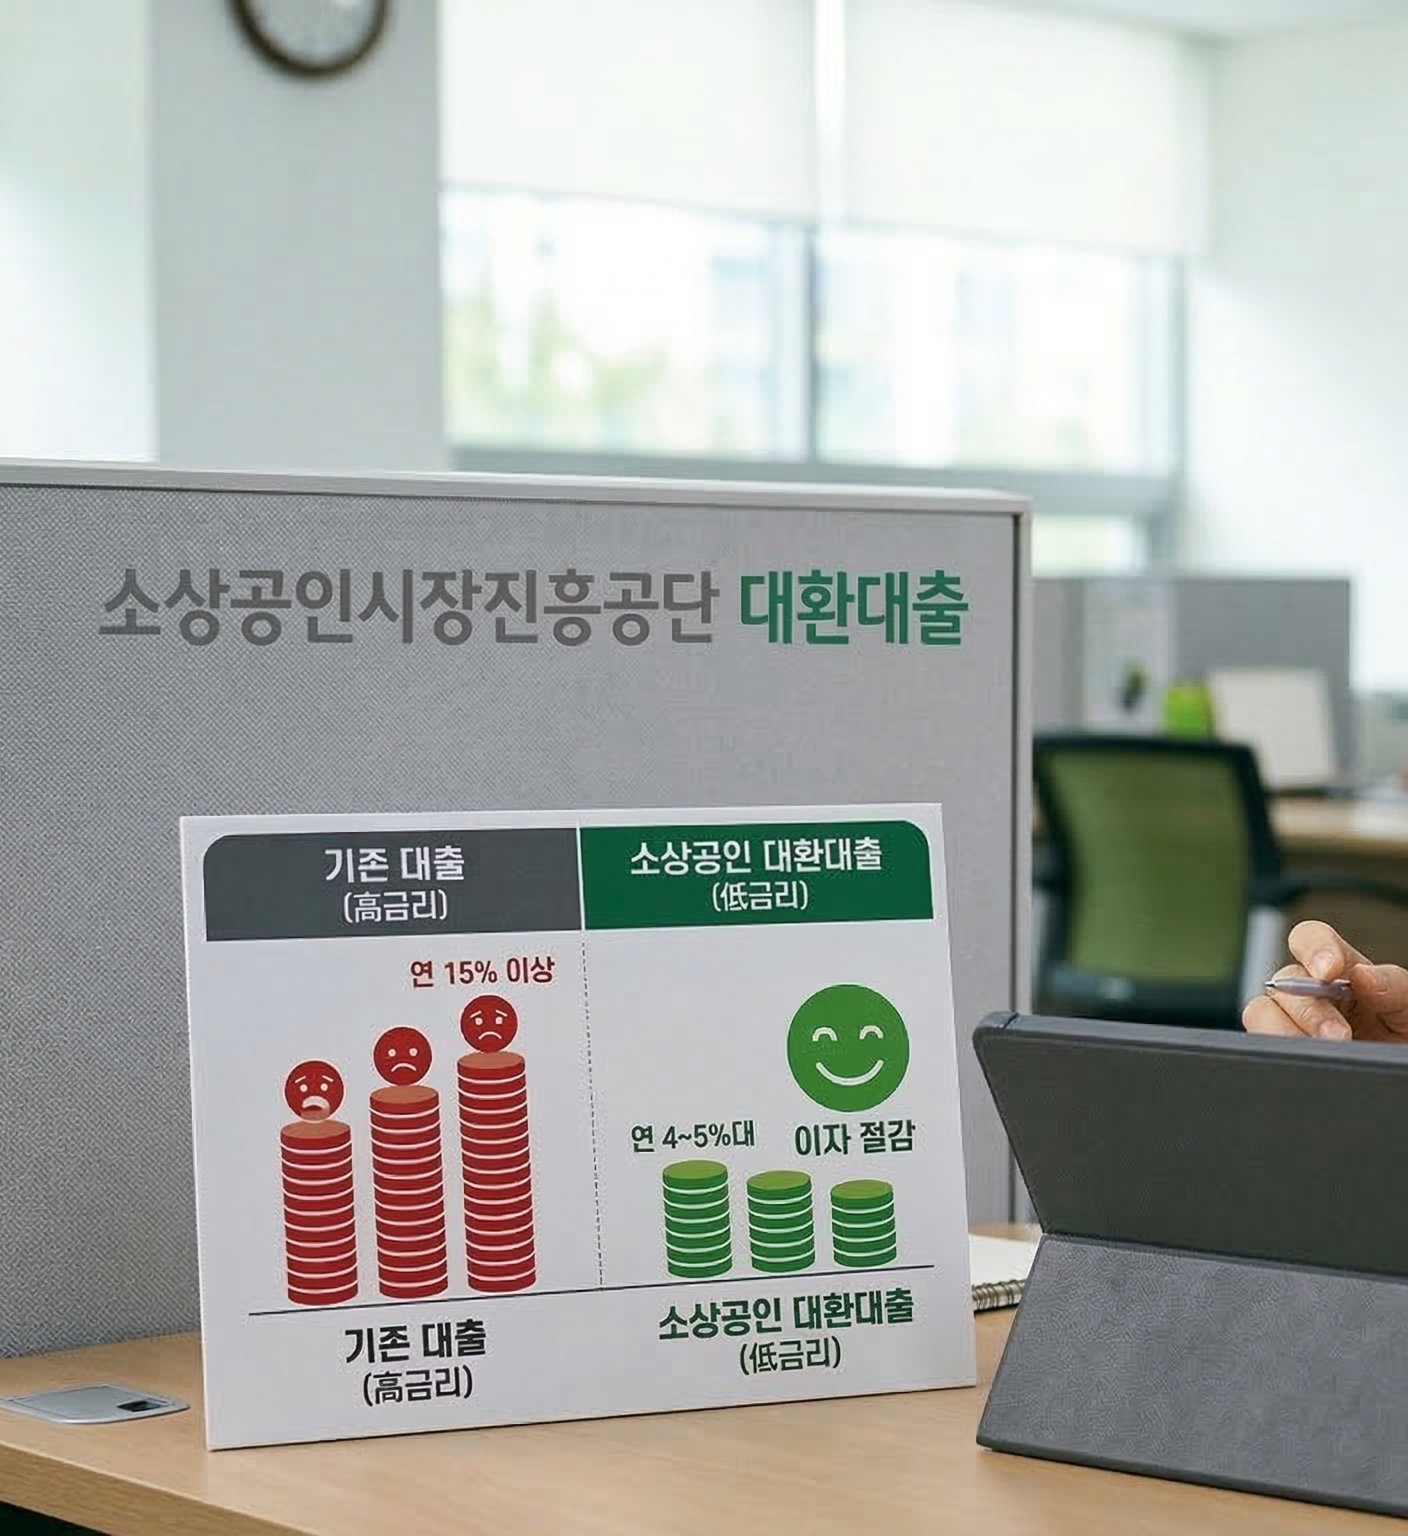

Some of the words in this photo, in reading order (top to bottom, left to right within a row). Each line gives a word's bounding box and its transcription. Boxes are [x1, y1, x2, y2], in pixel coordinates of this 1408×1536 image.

[97, 568, 720, 646] 소상공인시장진흥공단
[740, 568, 969, 646] 대환대출
[324, 848, 390, 884] 기존
[399, 845, 466, 882] 대출
[630, 840, 752, 876] 소상공인
[763, 836, 883, 873] 대환대출
[343, 889, 448, 924] (高금리)
[712, 879, 809, 912] (低금리)
[410, 960, 434, 989] 연
[444, 960, 498, 985] 15%
[506, 956, 556, 984] 이상
[631, 1125, 655, 1153] 연
[662, 1120, 755, 1149] 4~5%대
[794, 1123, 852, 1157] 이자
[859, 1119, 916, 1154] 절감
[658, 1298, 783, 1340] 소상공인
[792, 1287, 915, 1330] 대환대출
[344, 1324, 411, 1364] 기존
[421, 1318, 487, 1359] 대출
[739, 1336, 842, 1376] (低금리)
[362, 1365, 473, 1407] (高금리)
